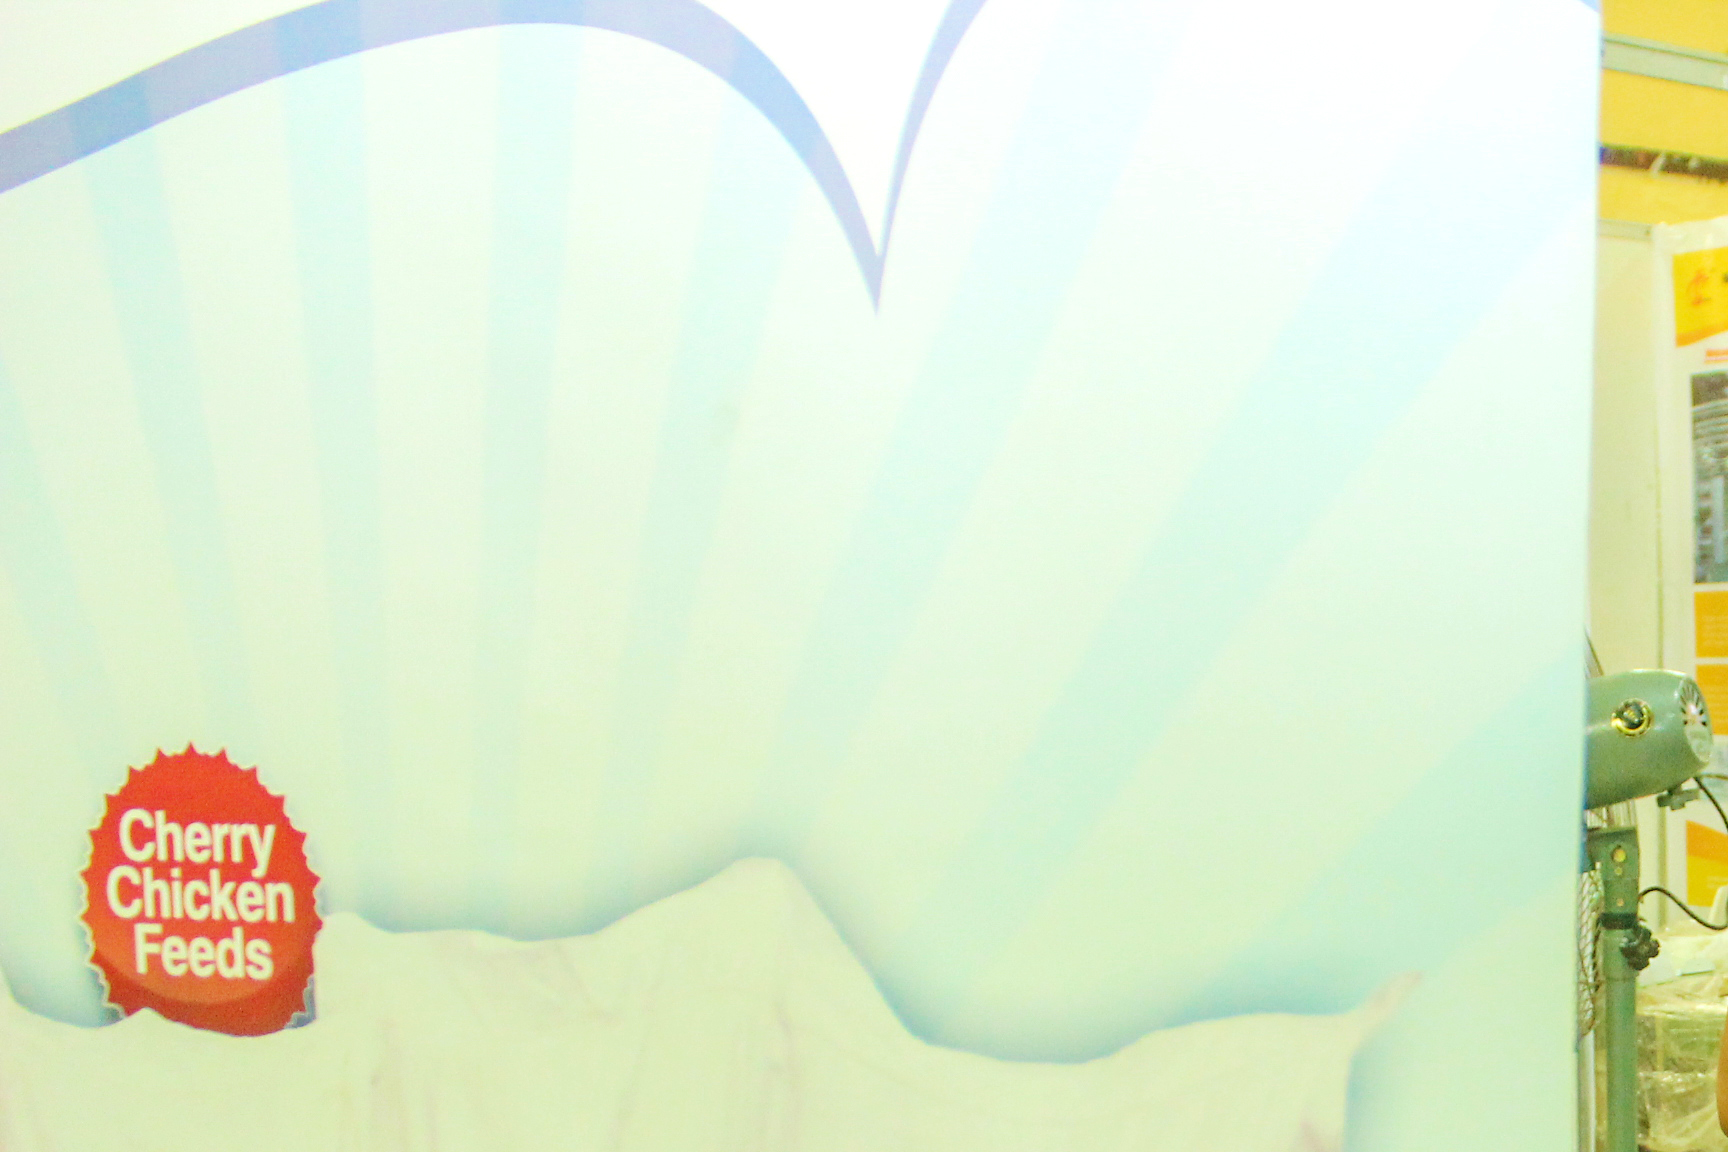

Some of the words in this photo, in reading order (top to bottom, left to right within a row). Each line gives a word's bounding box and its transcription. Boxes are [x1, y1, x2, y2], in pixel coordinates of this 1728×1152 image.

[119, 808, 276, 878] Cherry
[107, 865, 296, 923] Chicken
[134, 922, 275, 980] Feeds
